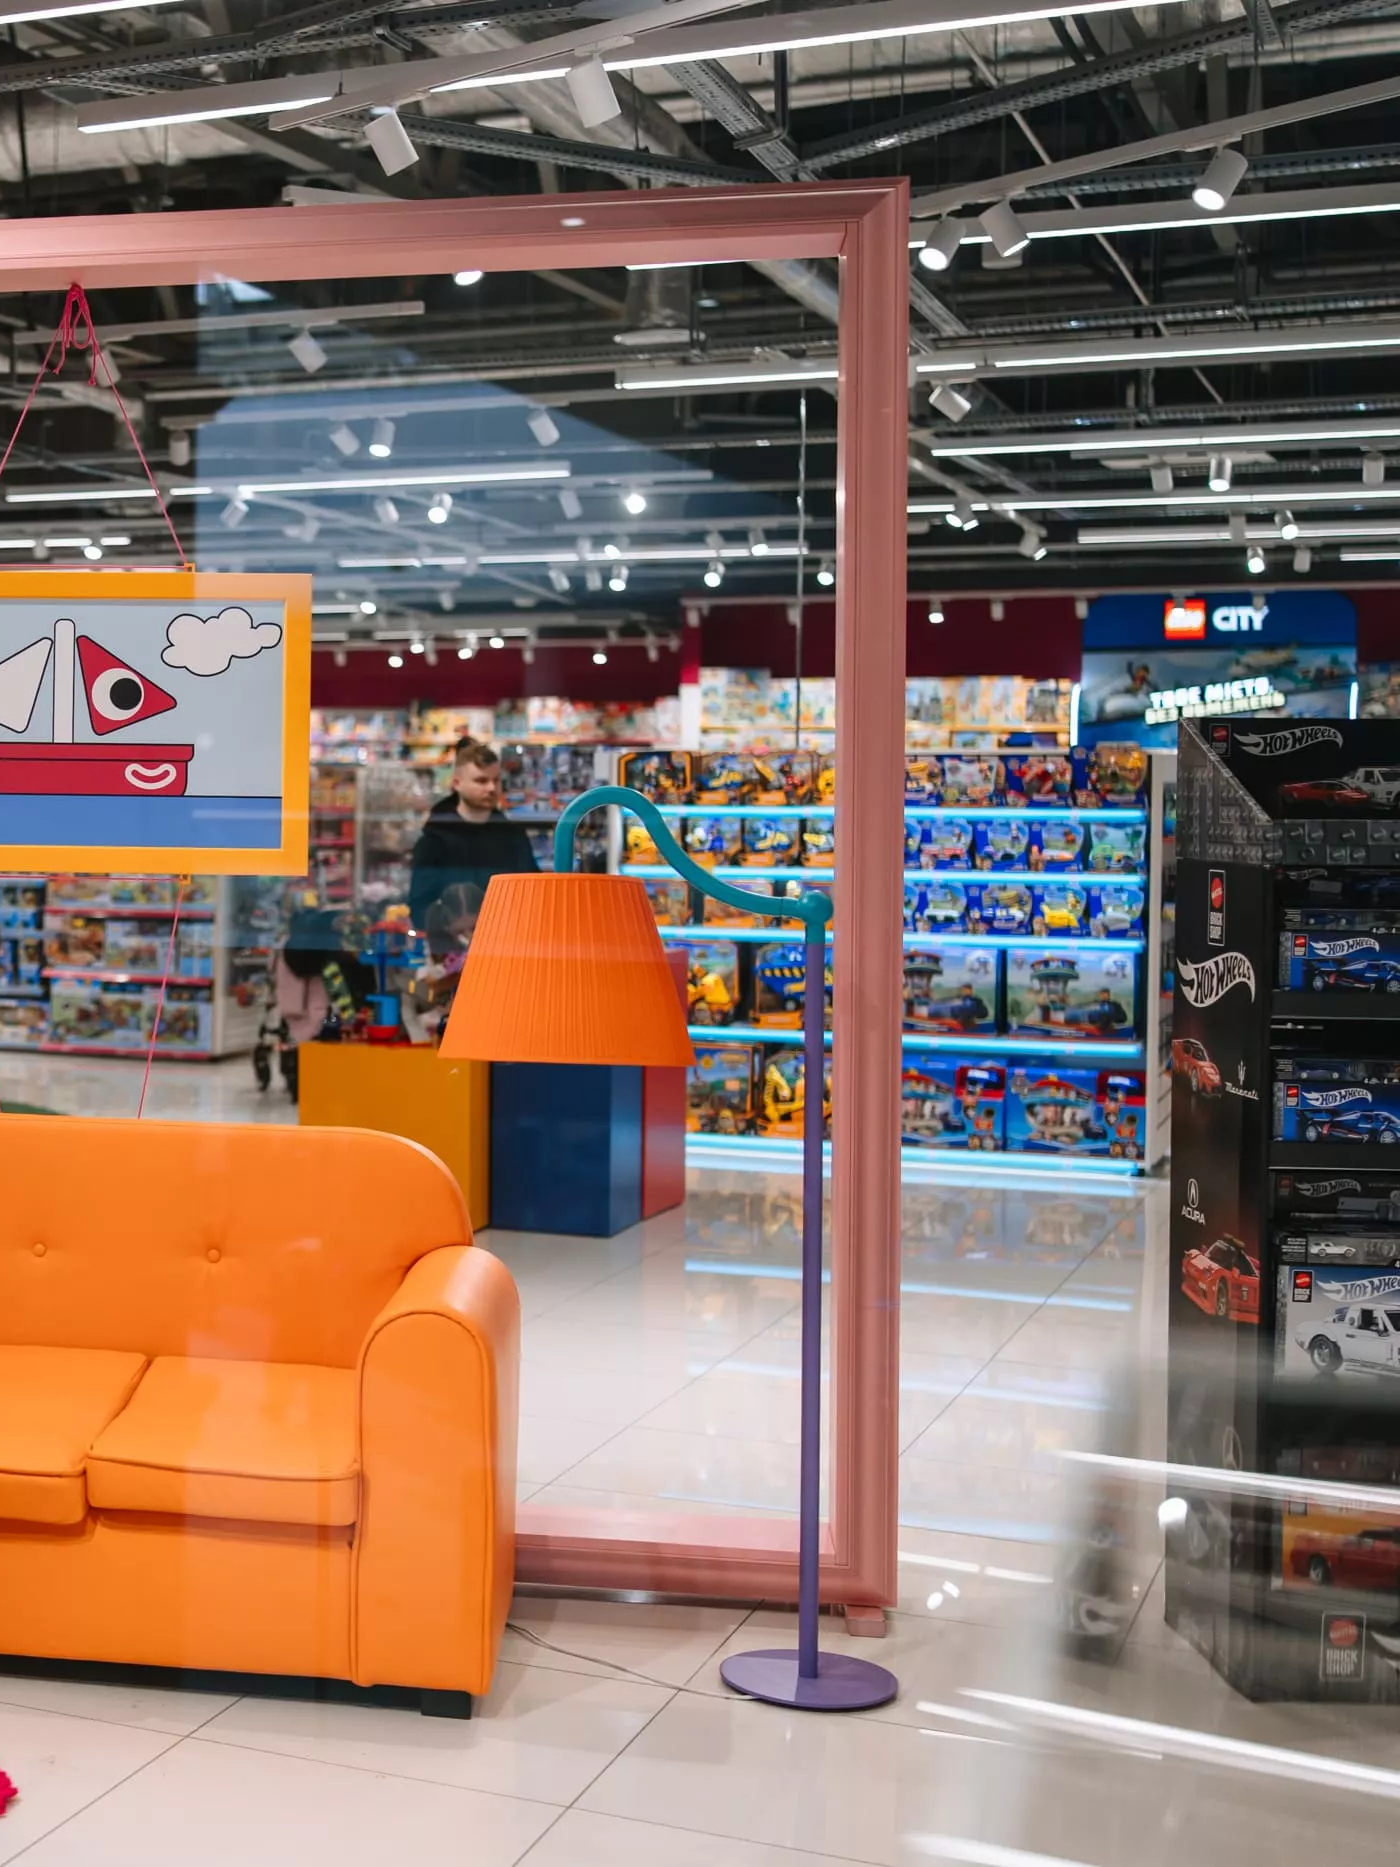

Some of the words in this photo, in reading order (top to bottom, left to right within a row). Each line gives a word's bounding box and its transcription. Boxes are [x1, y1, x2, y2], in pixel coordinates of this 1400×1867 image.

[1212, 606, 1269, 631] CITY
[1260, 734, 1292, 754] HOT
[1194, 964, 1215, 1004] HOT
[1181, 1206, 1206, 1225] ACURA
